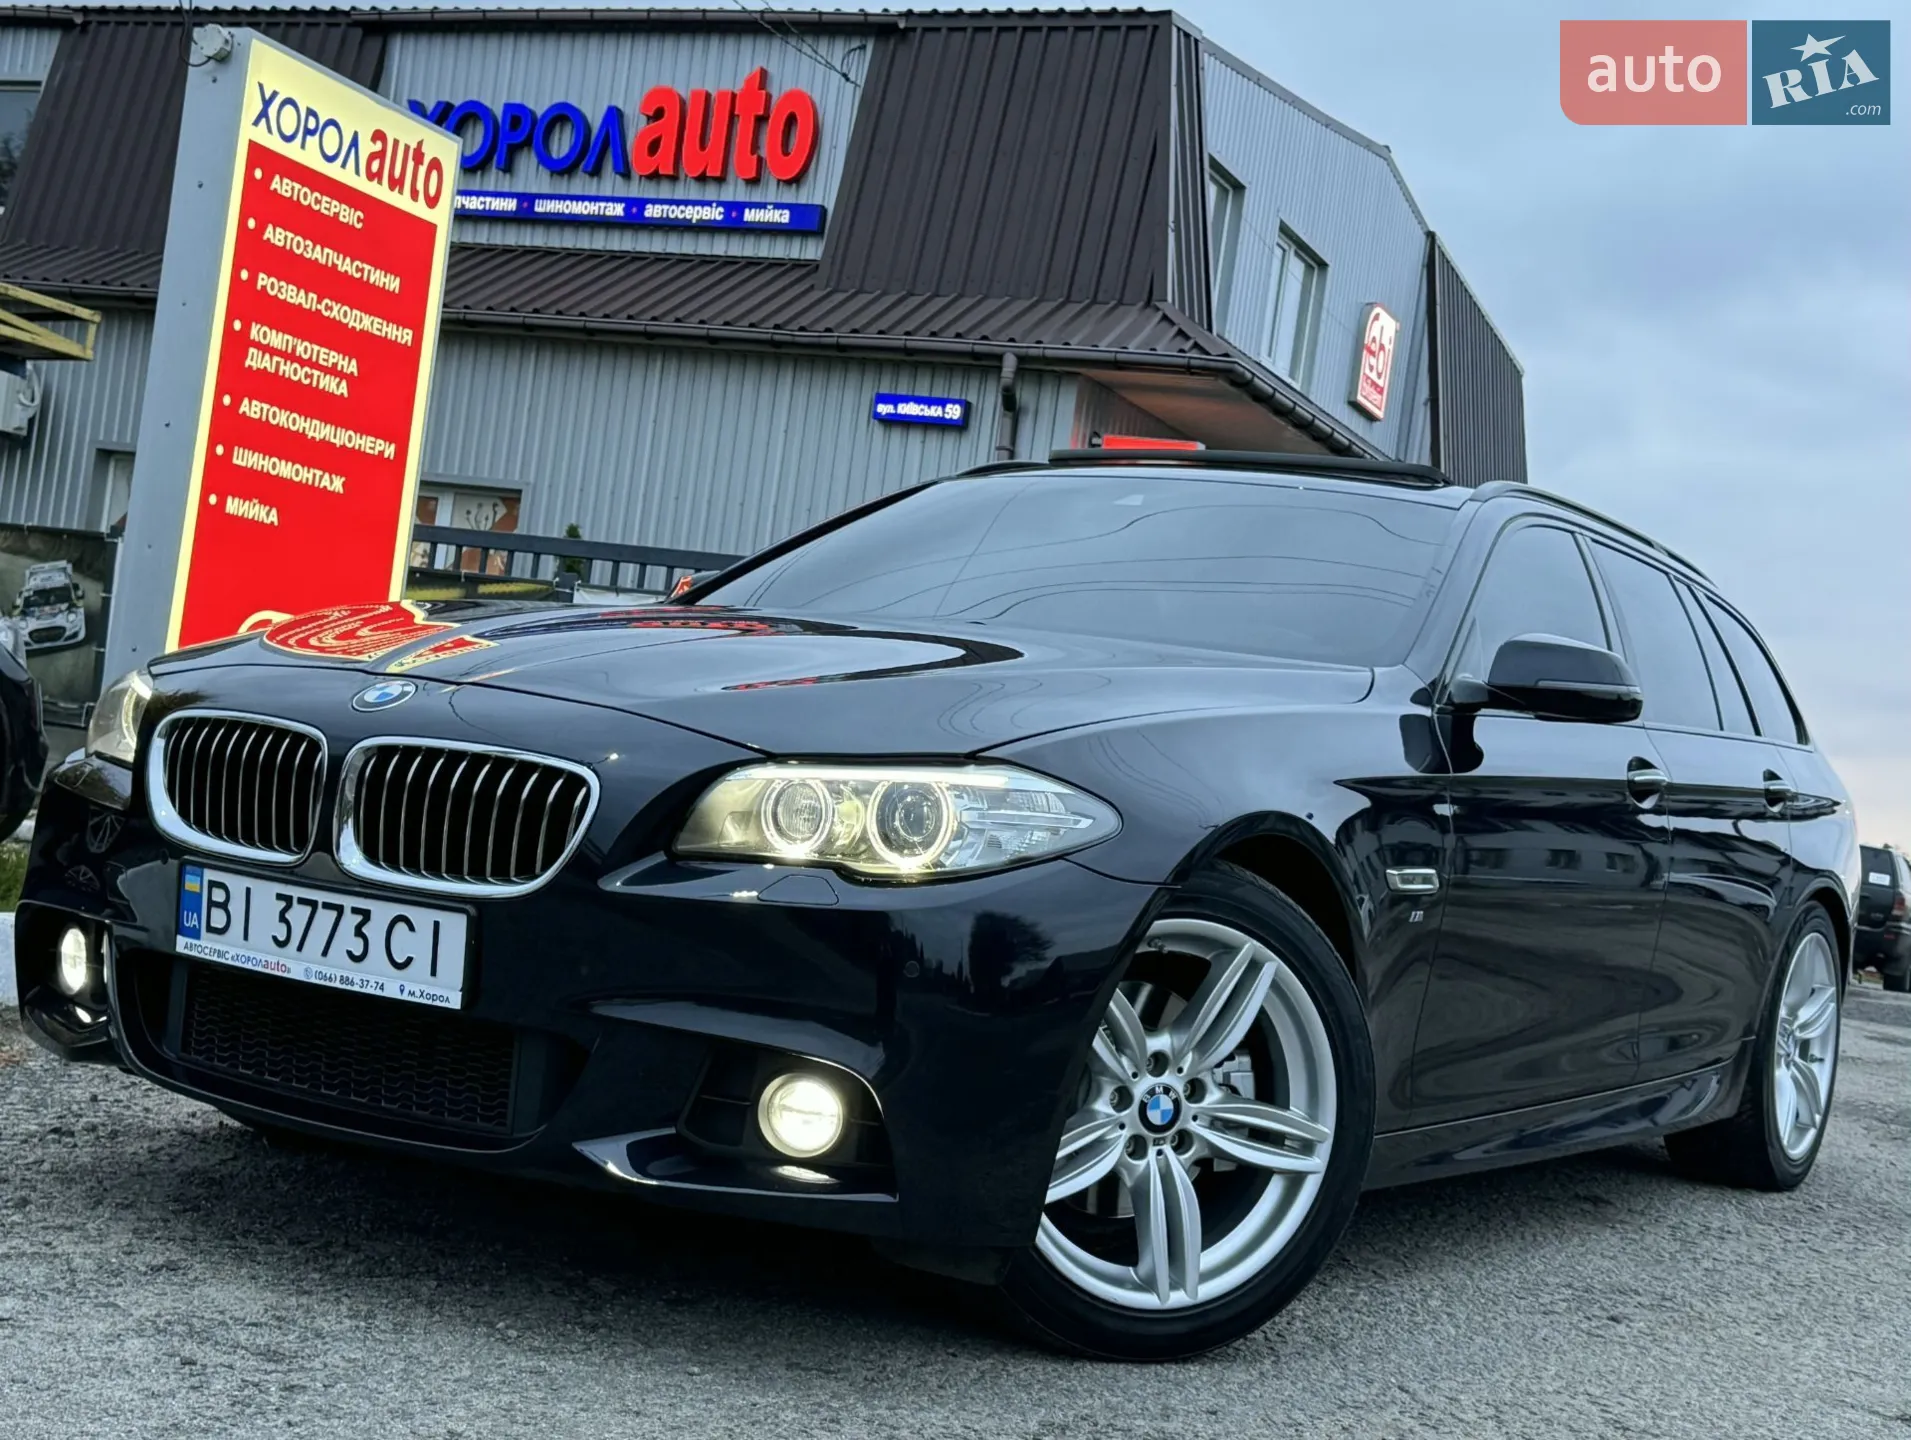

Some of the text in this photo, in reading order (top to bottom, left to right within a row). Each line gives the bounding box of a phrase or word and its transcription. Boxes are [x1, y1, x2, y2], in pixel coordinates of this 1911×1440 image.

[269, 173, 365, 229] АВТОСЕРВІС
[534, 198, 626, 217] шиномонтаж
[644, 202, 725, 223] автосервіс
[743, 204, 791, 223] мийка
[262, 223, 401, 295] АВТОЗАПЧАСТИНИ
[256, 272, 413, 347] РОЗВАЛ-СХОДЖЕННЯ
[244, 346, 349, 398] ДІАГНОСТИКА
[250, 321, 359, 377] КОМП'ЮТЕРНА
[238, 396, 396, 461] АВТОКОНДИЦІОНЕРИ
[944, 403, 962, 420] 59
[232, 446, 346, 494] ШИНОМОНТАЖ
[225, 495, 279, 526] МИЙКА
[183, 910, 200, 929] UA
[205, 879, 441, 978] BI 3773 CI
[183, 941, 230, 961] АВТОСЕРВІС
[314, 970, 338, 984] (066)
[338, 974, 385, 993] 886-37-74
[1142, 1086, 1177, 1103] BMW
